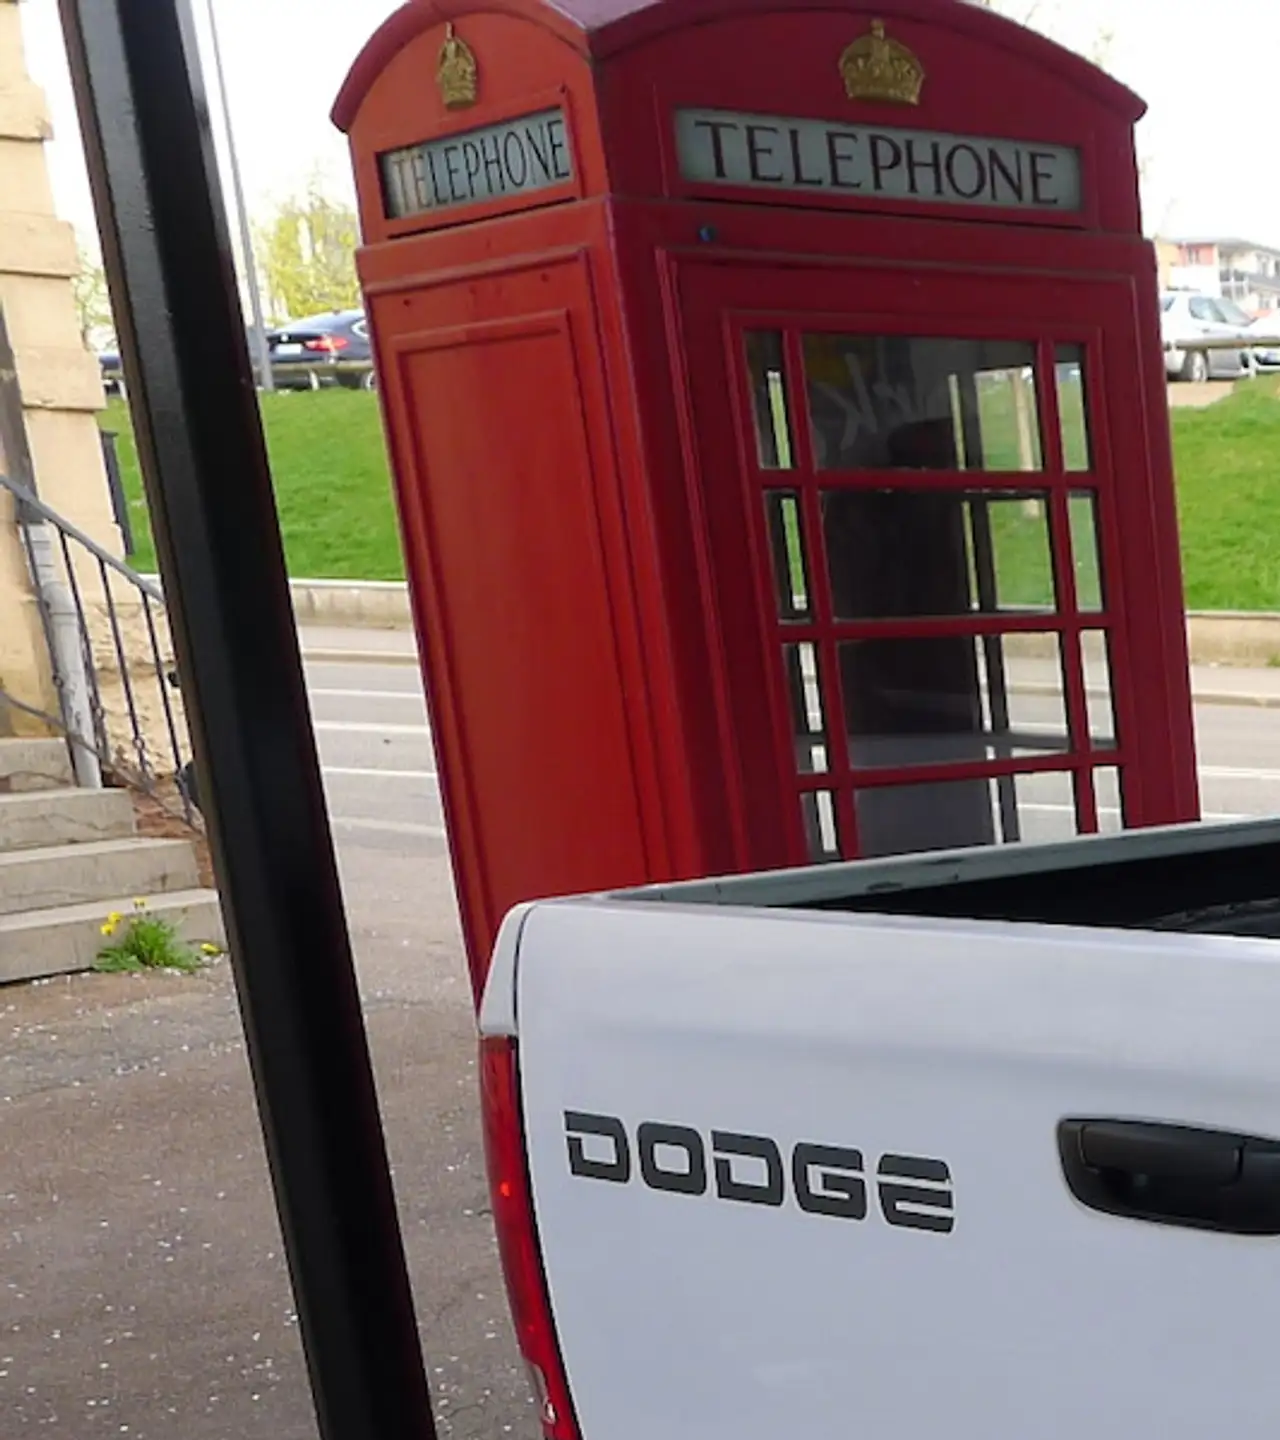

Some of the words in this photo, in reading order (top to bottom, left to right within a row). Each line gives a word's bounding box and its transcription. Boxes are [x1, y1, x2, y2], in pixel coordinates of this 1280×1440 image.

[391, 119, 570, 214] TELEPHONE
[694, 119, 1059, 205] TELEPHONE
[563, 1109, 955, 1235] DODGE
